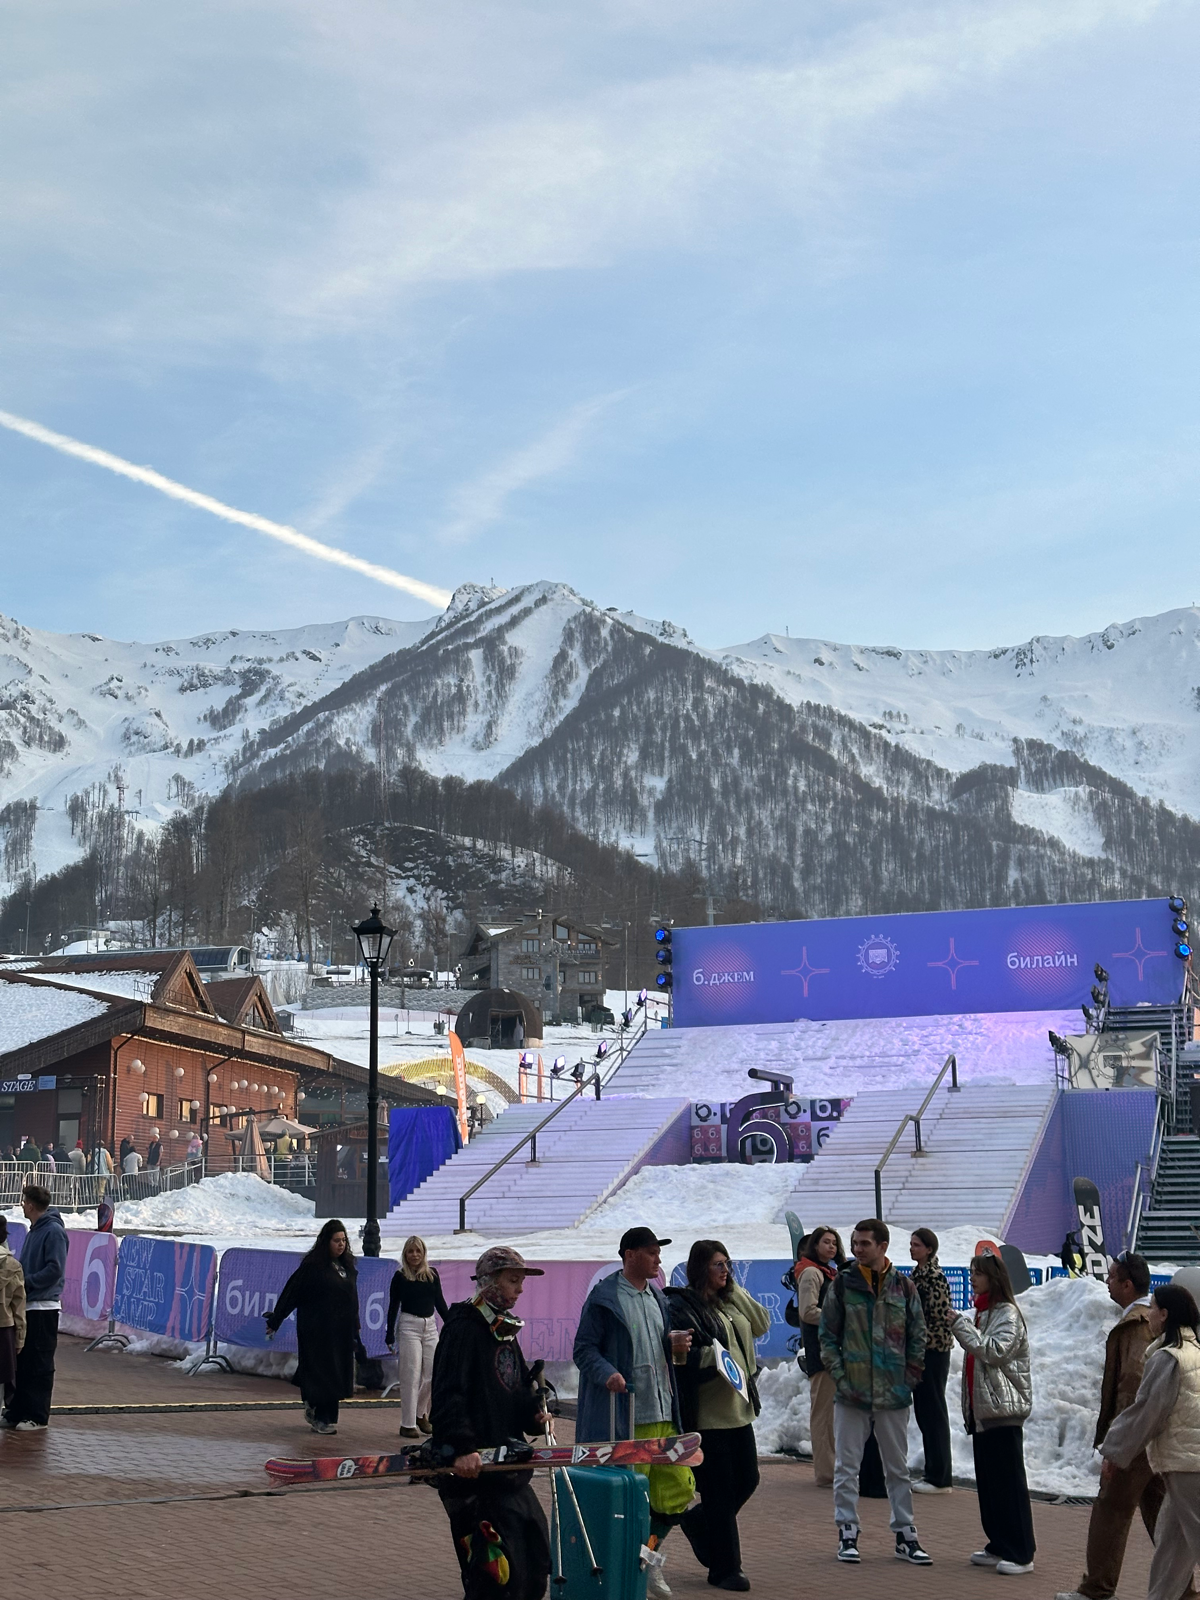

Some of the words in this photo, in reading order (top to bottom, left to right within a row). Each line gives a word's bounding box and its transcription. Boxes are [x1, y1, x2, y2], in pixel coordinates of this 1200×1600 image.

[1007, 951, 1078, 969] билайн
[1, 1080, 36, 1092] STAGE
[119, 1236, 156, 1269] NEW
[123, 1266, 165, 1303] STAR
[113, 1293, 157, 1331] CAMP
